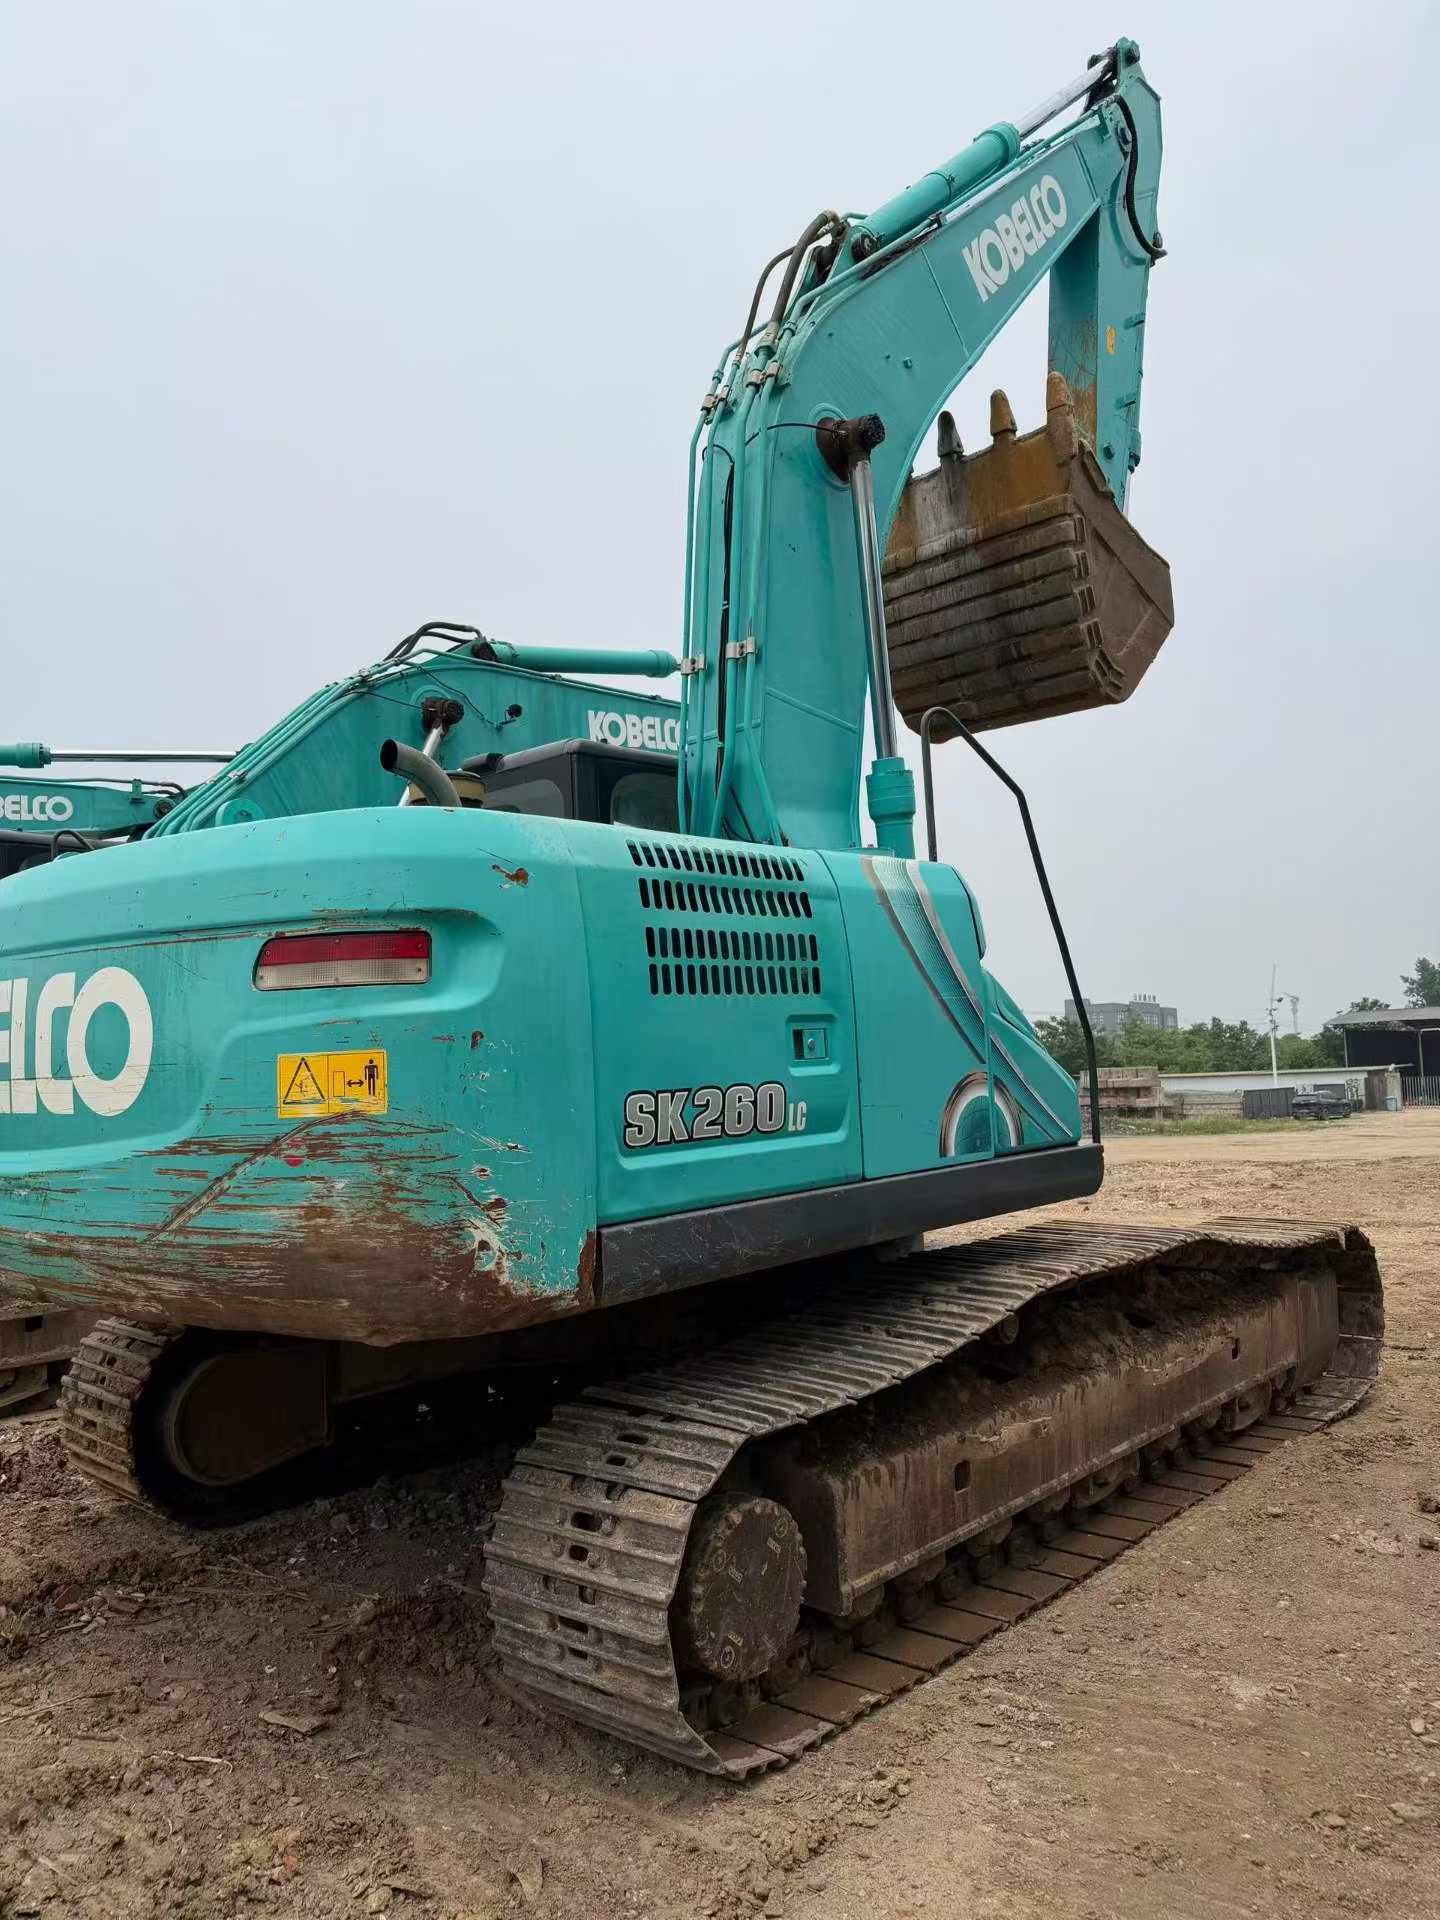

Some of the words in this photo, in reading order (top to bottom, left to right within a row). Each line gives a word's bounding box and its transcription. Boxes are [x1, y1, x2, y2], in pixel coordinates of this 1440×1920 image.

[961, 174, 1067, 303] KOBELCO
[587, 710, 681, 751] KOBELC
[0, 794, 74, 822] ELCO
[624, 1081, 786, 1148] SK260
[787, 1101, 807, 1132] LC
